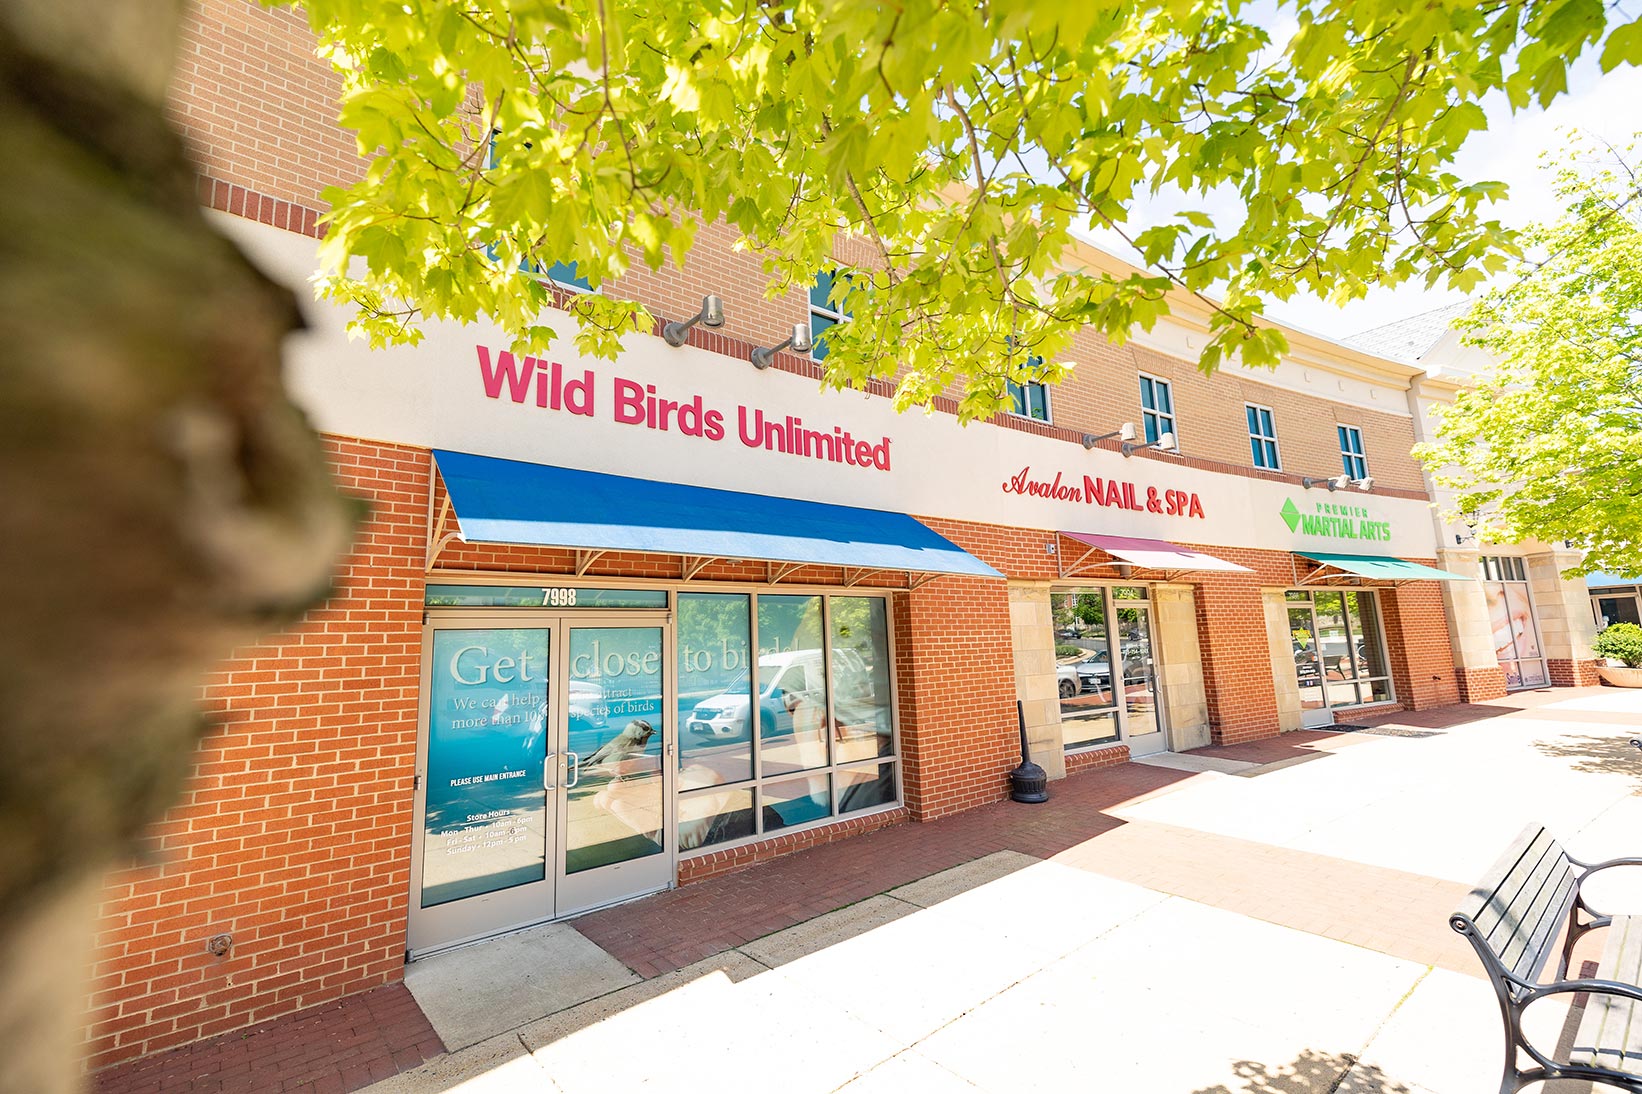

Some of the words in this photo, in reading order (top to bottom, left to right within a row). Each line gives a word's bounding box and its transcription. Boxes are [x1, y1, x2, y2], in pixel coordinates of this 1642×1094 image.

[476, 345, 595, 417] Wild
[613, 376, 724, 441] Birds
[737, 404, 891, 471] Unlimited
[1002, 466, 1082, 502] Avalon
[1083, 475, 1144, 511] NAIL
[1146, 486, 1164, 514] &
[1165, 489, 1205, 519] SPA
[1316, 502, 1368, 518] PREMIER
[1302, 513, 1358, 539] MARTIAL
[1359, 520, 1391, 541] ARTS
[541, 588, 577, 606] 7998
[450, 645, 534, 685] Get
[571, 639, 659, 678] close
[682, 645, 712, 673] to
[454, 697, 477, 710] We
[512, 692, 540, 707] help
[452, 717, 488, 729] more
[571, 705, 610, 720] species
[613, 701, 625, 714] of
[627, 700, 654, 713] birds
[450, 777, 472, 787] PLEASE
[472, 775, 484, 784] USE
[484, 773, 499, 782] MAIN
[499, 769, 527, 780] ENTRANCE
[466, 814, 487, 822] Store
[488, 809, 511, 818] Hours
[440, 830, 459, 838] Mon
[464, 825, 483, 834] Thur
[492, 820, 512, 829] 10am
[446, 838, 458, 846] Fri
[463, 835, 476, 843] Sat
[486, 830, 505, 839] 10am
[446, 844, 477, 856] Sunday
[482, 839, 504, 849] 12pm
